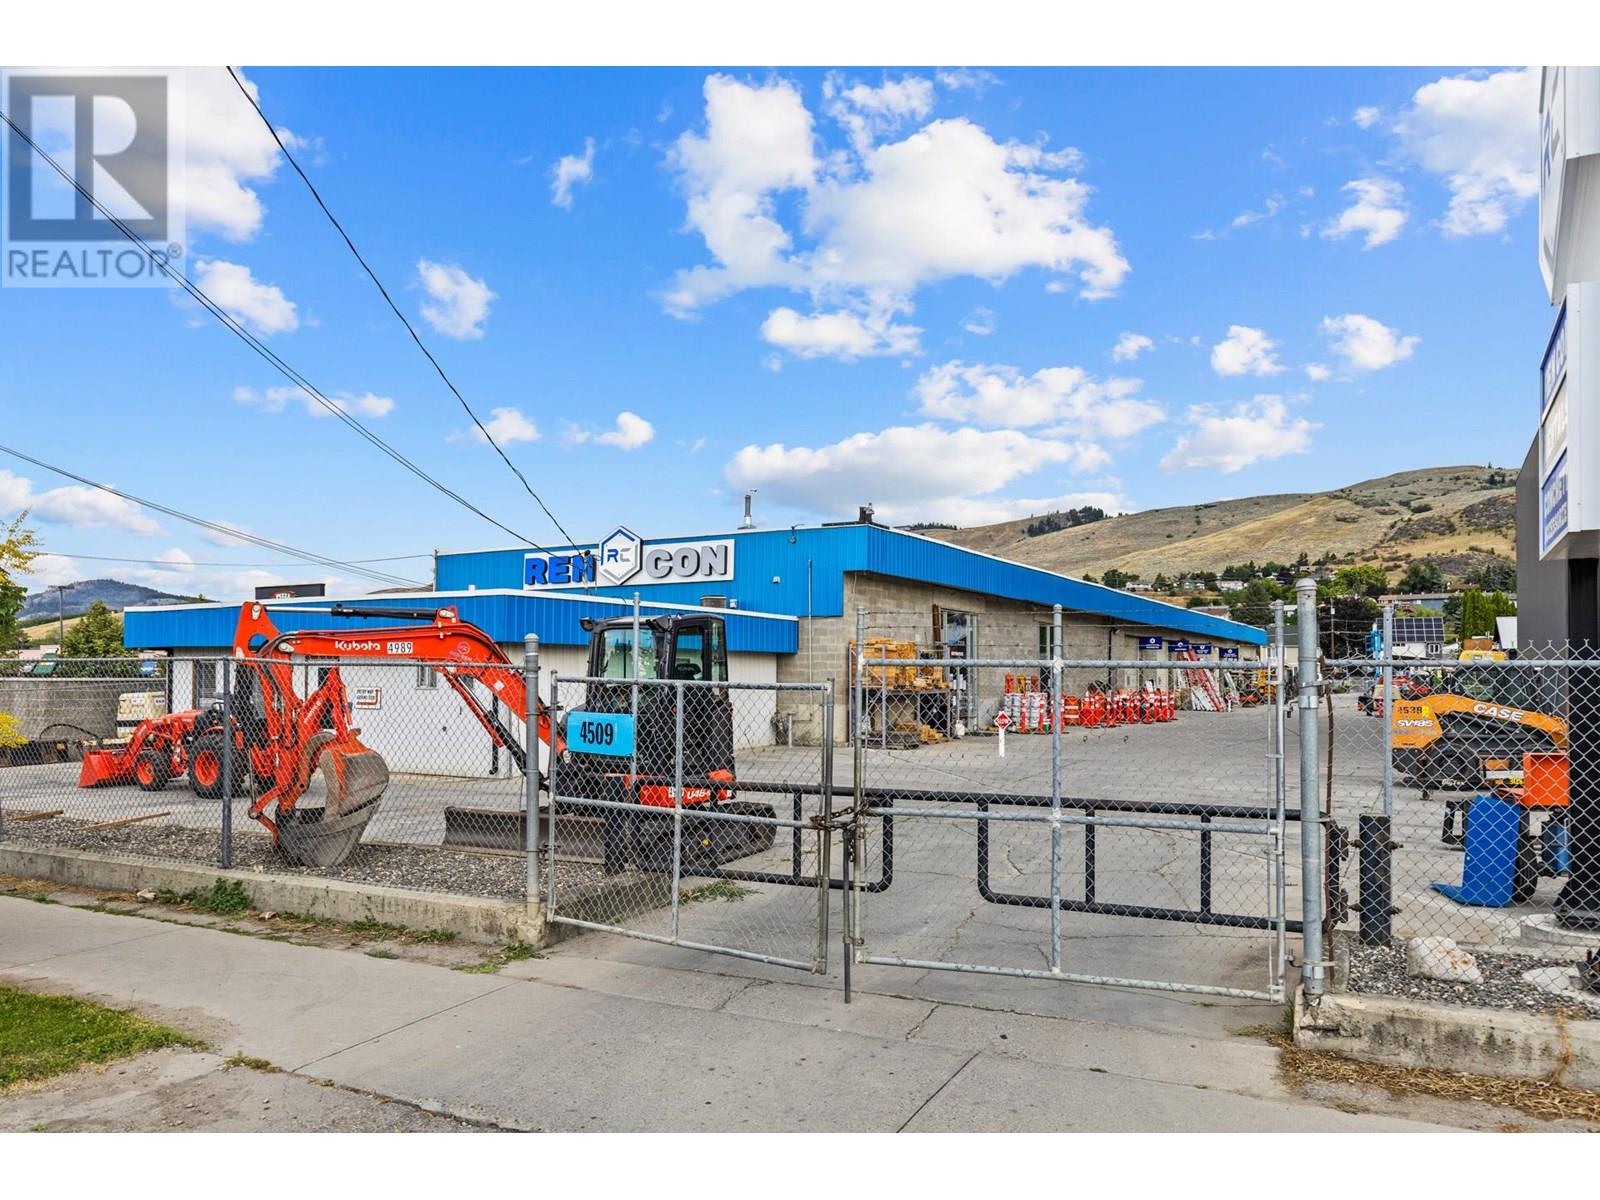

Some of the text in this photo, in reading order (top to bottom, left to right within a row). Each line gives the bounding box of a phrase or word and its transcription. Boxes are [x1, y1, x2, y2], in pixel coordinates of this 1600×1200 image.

[525, 545, 728, 585] REN RC CON
[335, 640, 412, 654] Kubota 4989
[1473, 703, 1524, 721] CASE
[579, 720, 614, 746] 4509
